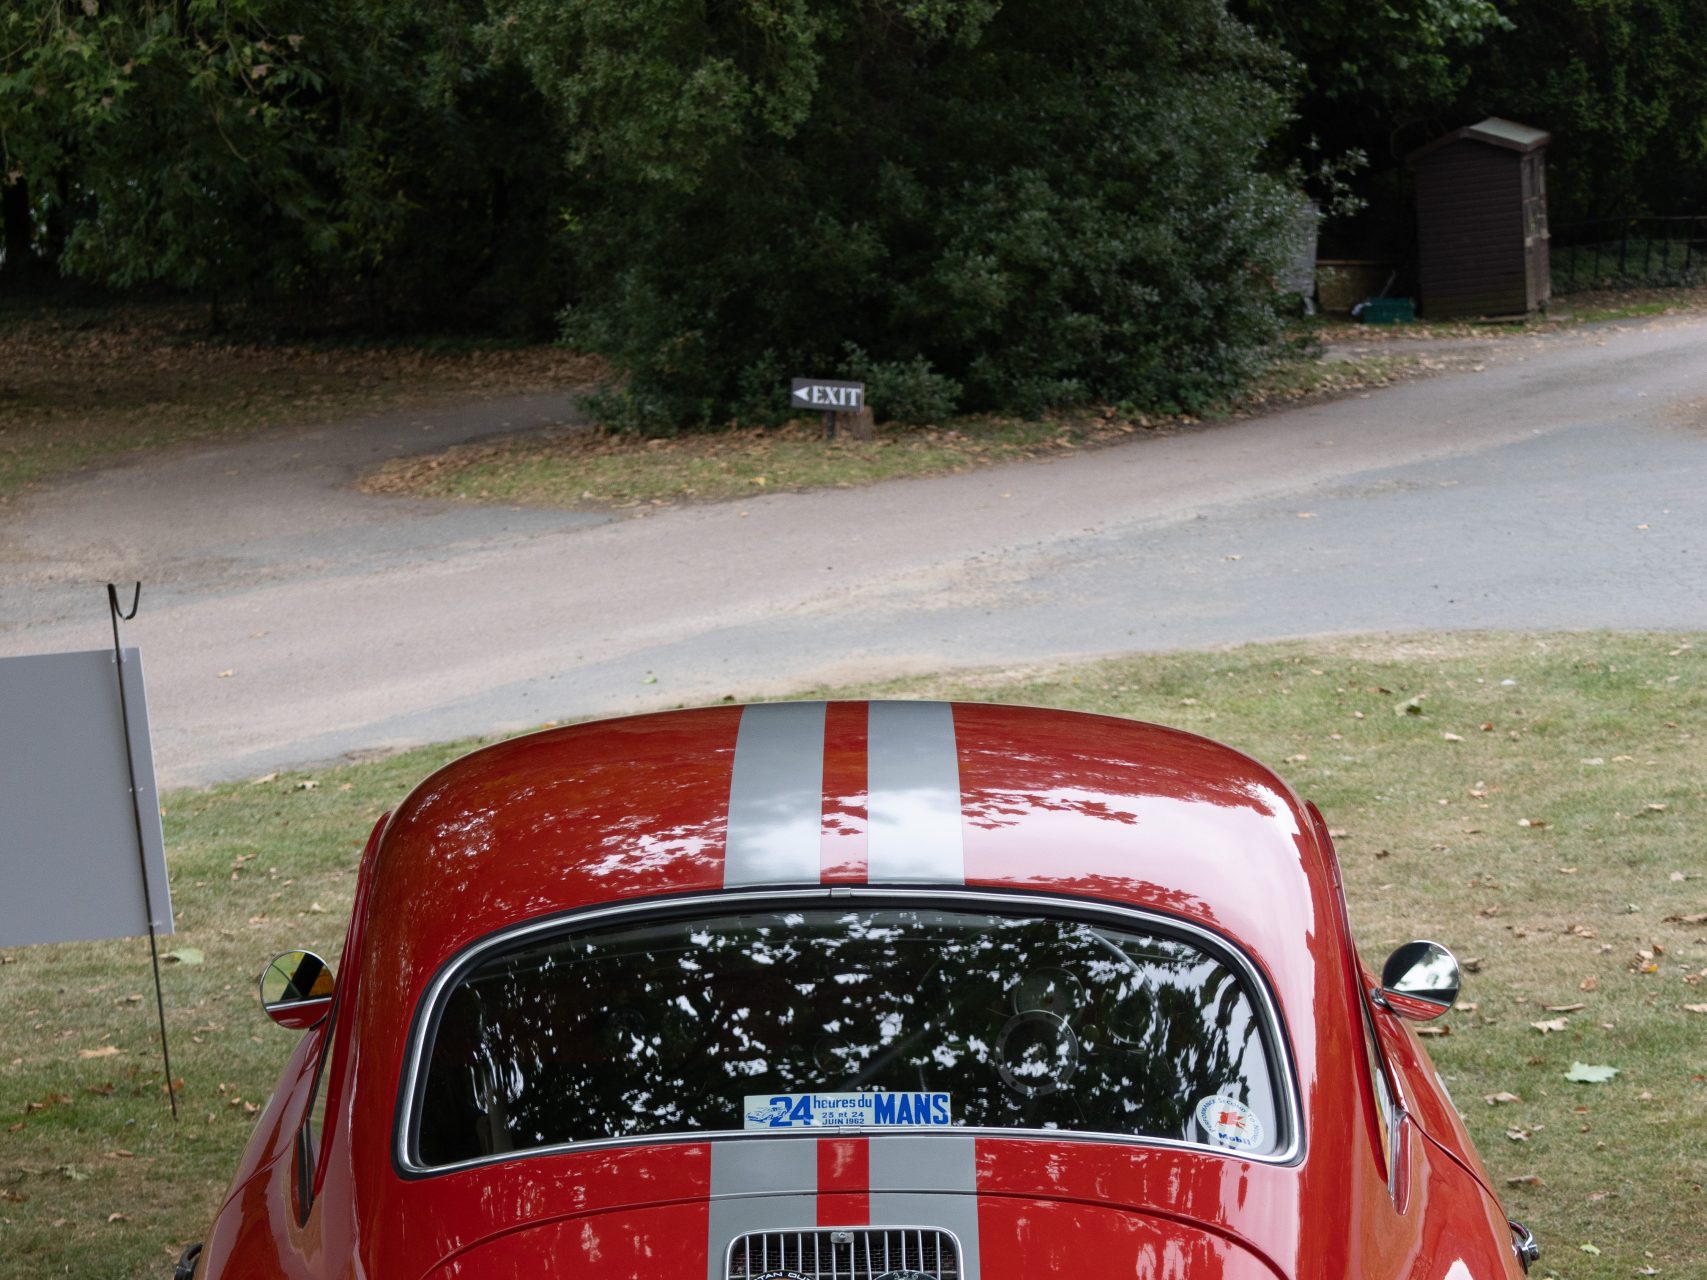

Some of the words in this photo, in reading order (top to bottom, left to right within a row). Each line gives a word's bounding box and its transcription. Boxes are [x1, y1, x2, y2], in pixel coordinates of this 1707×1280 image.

[812, 385, 861, 407] EXIT
[769, 1095, 814, 1127] 24
[814, 1095, 856, 1109] heures
[858, 1094, 872, 1108] du
[874, 1094, 949, 1125] MANS
[822, 1118, 844, 1126] JUIN
[1218, 1132, 1251, 1146] Mobil
[892, 1272, 919, 1280] 356
